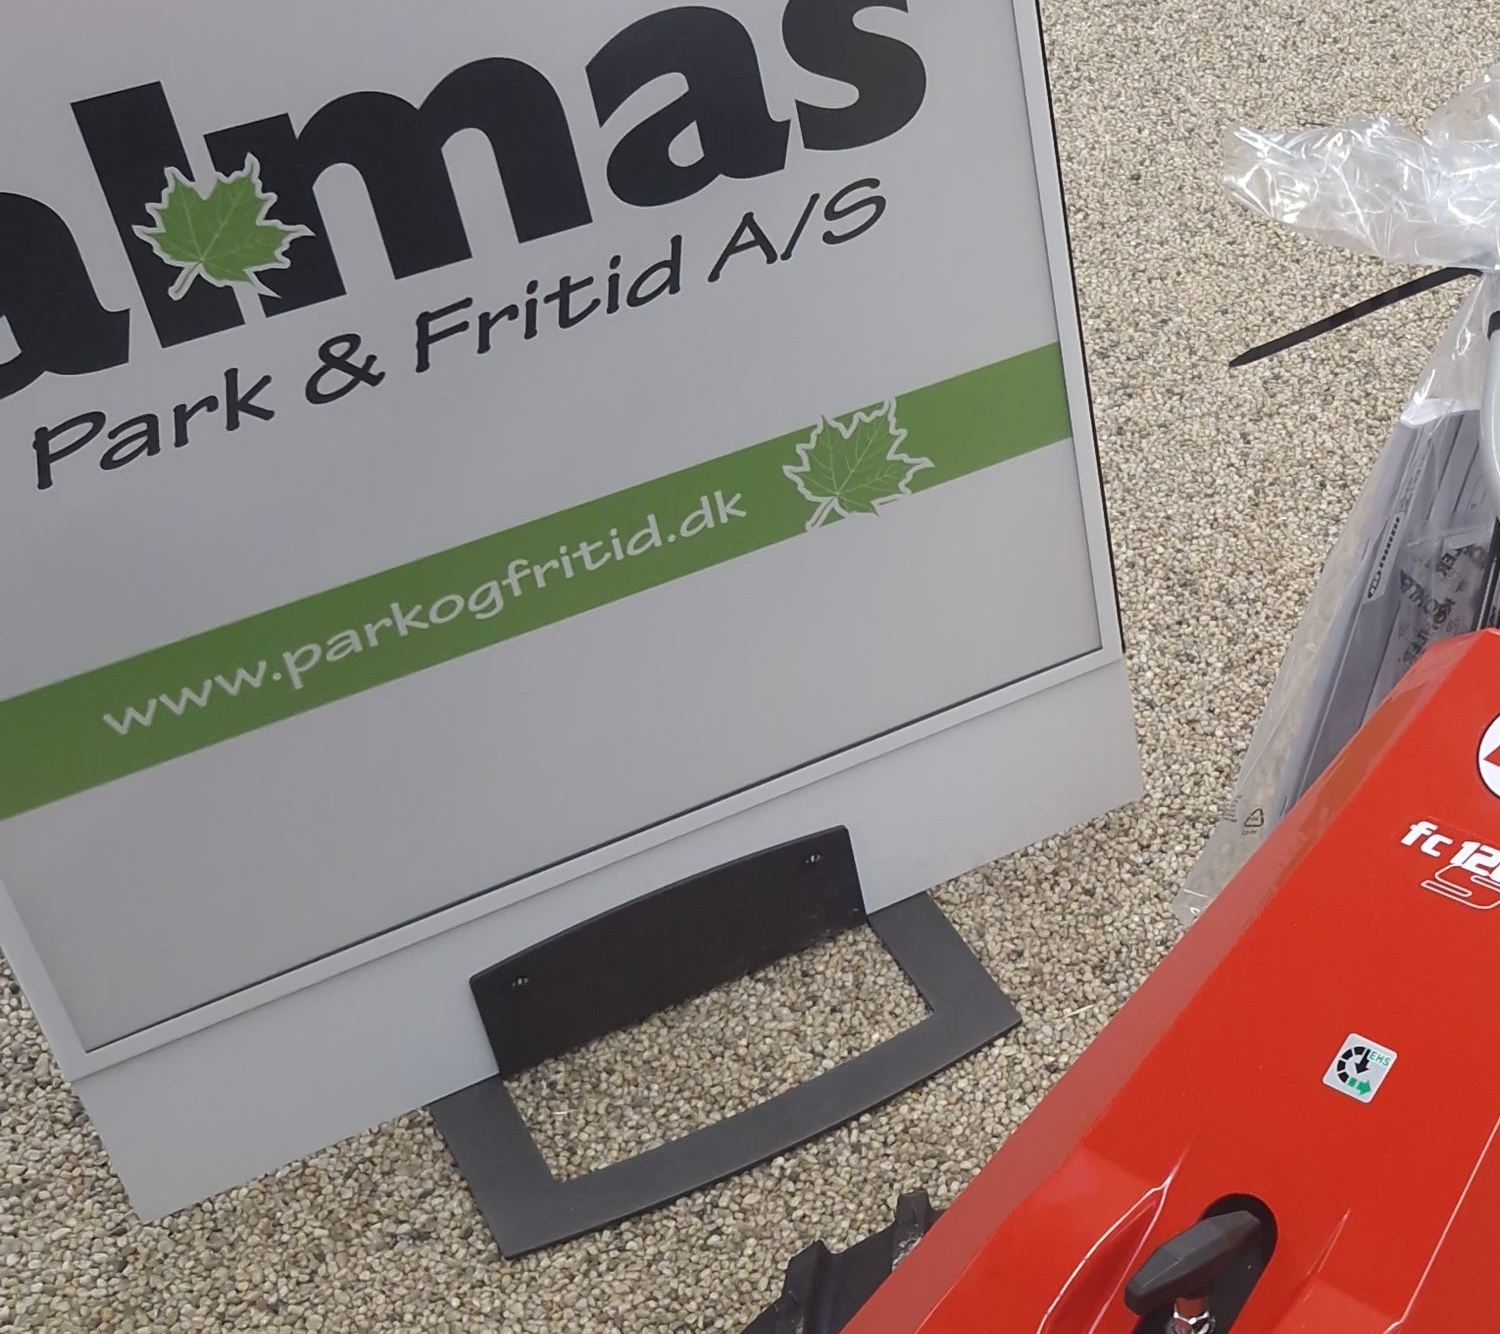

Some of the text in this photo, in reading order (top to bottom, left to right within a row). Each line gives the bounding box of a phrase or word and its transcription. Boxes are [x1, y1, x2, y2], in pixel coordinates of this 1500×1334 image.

[32, 178, 888, 489] Park & Fritid A/S
[102, 490, 747, 736] www.parkogfritid.dk
[1401, 821, 1453, 857] fc
[1370, 1051, 1390, 1067] EHS
